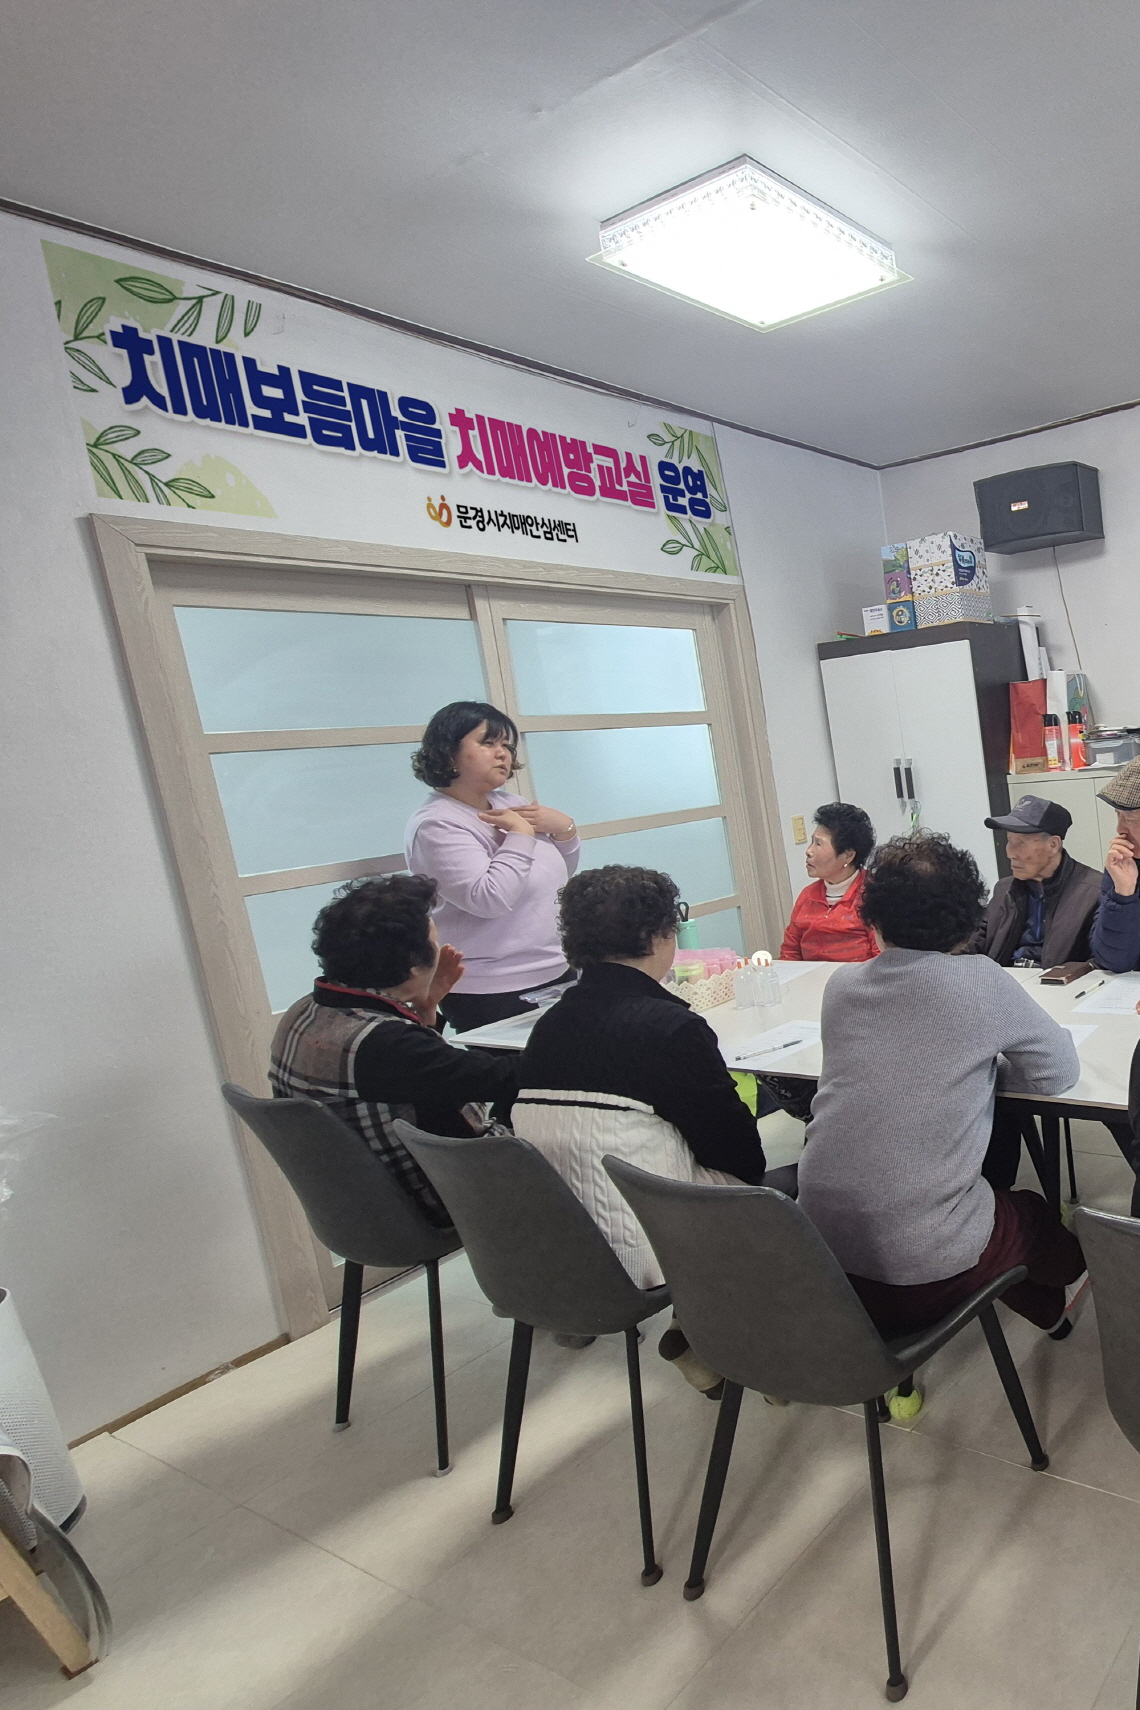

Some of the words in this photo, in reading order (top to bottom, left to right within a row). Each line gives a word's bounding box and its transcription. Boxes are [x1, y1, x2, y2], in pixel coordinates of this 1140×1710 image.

[109, 323, 447, 469] 치매보듬마을
[448, 407, 656, 509] 치매예방교실
[658, 460, 712, 520] 운영
[456, 504, 579, 543] 문경시치매안심센터
